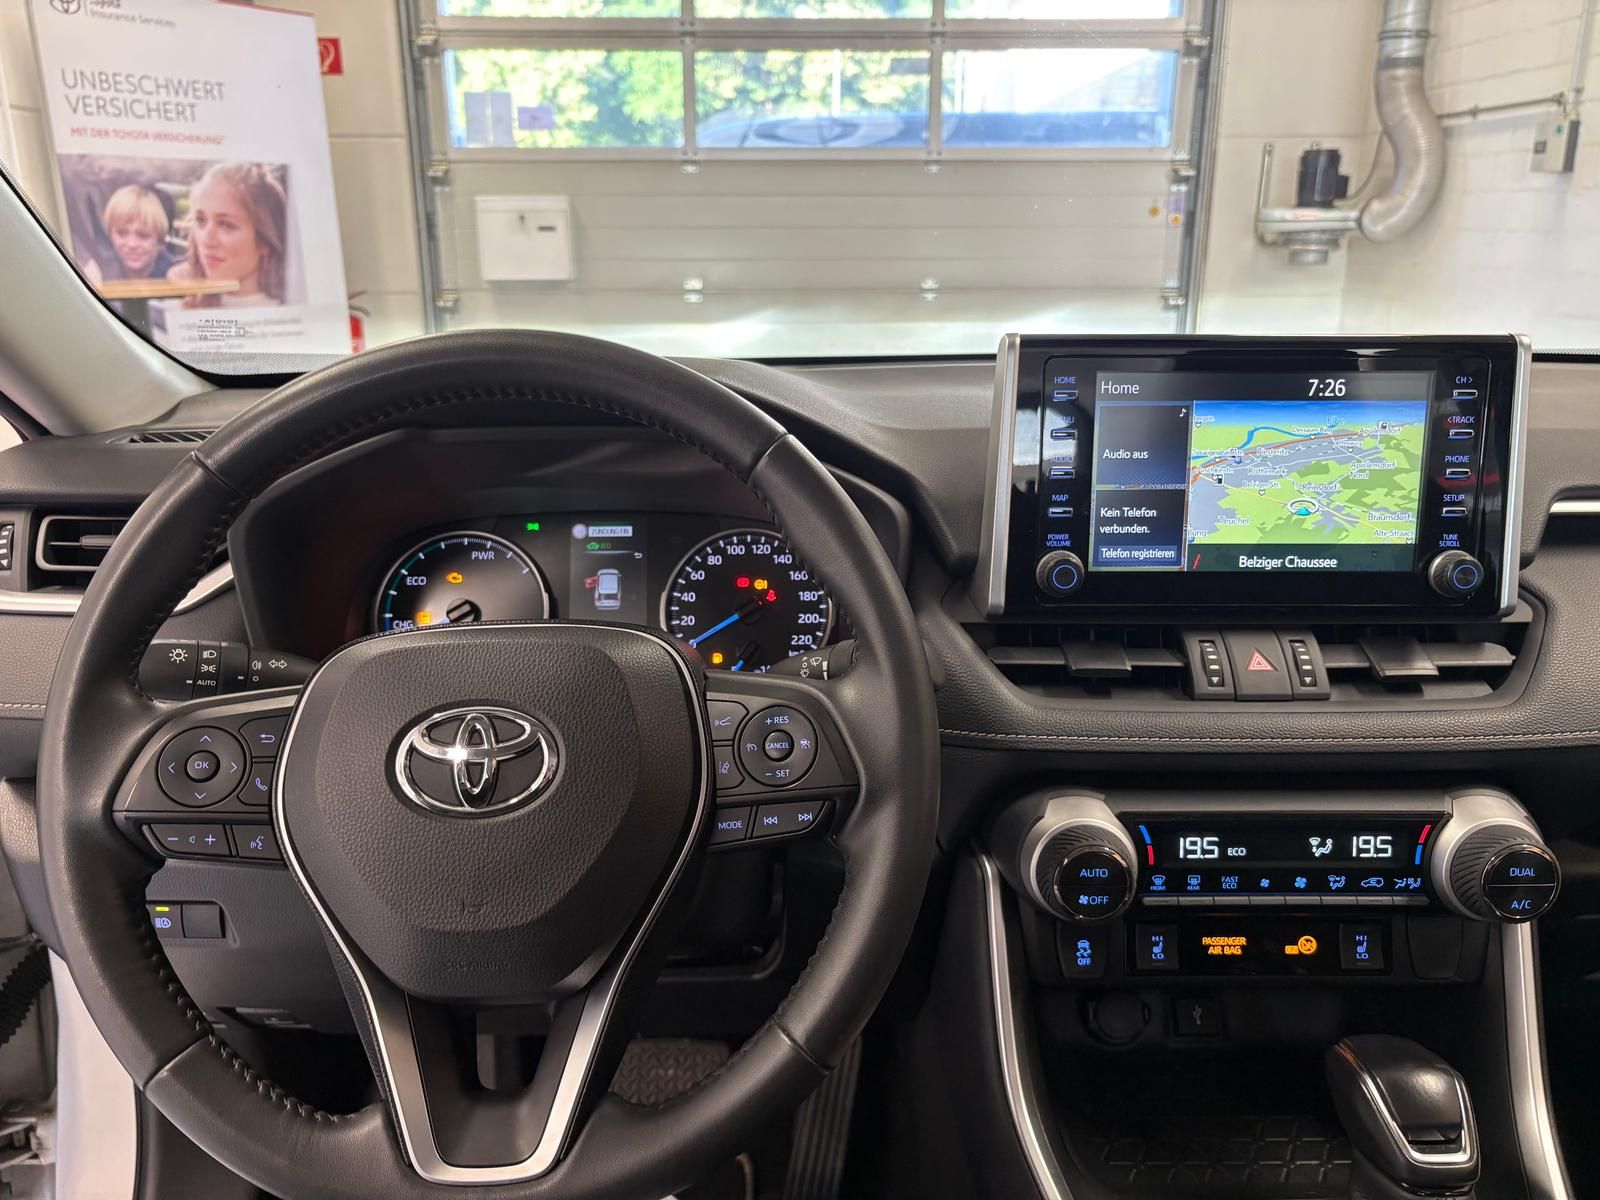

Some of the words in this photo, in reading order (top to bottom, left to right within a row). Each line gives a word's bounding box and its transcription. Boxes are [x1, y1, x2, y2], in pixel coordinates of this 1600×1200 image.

[61, 68, 225, 102] UNBESCHWERT
[64, 94, 198, 123] VERSICHERT
[70, 126, 88, 137] MIT
[91, 128, 109, 138] DER
[112, 129, 149, 141] TOYOTA
[1054, 376, 1076, 384] HOME
[1101, 380, 1140, 394] Home
[1308, 379, 1346, 397] 7:26
[1051, 455, 1073, 463] AUDIO
[1103, 449, 1130, 459] Audio
[1132, 451, 1149, 459] aus
[1444, 455, 1470, 463] PHONE
[1302, 483, 1338, 491] Reinsdorf
[1052, 494, 1068, 502] MAP
[1443, 494, 1465, 502] SETUP
[1100, 507, 1120, 517] Kein
[1122, 507, 1157, 517] Telefon
[1368, 512, 1411, 521] Braunsdorf
[1100, 524, 1150, 533] verbunden.
[726, 545, 745, 555] 100
[752, 544, 771, 554] 120
[1101, 548, 1130, 559] Telefon
[1131, 548, 1175, 560] registrieren
[471, 551, 495, 560] PWR
[707, 555, 722, 565] 80
[772, 555, 792, 564] 140
[1239, 555, 1283, 570] Belziger
[1285, 555, 1338, 568] Chaussee
[690, 570, 705, 580] 60
[789, 570, 808, 580] 160
[406, 576, 427, 585] ECO
[681, 592, 696, 602] 40
[798, 591, 818, 601] 180
[680, 615, 695, 625] 20
[798, 613, 819, 624] 200
[393, 620, 414, 630] CHG
[791, 635, 813, 645] 220
[774, 716, 789, 724] RES
[195, 761, 209, 769] OK
[775, 769, 790, 778] SET
[718, 820, 743, 830] MODE
[1179, 837, 1220, 859] 19.5
[1227, 847, 1247, 856] ECO
[1352, 836, 1393, 857] 19.5
[1080, 868, 1109, 878] AUTO
[1509, 867, 1536, 877] DUAL
[1089, 895, 1109, 904] OFF
[1511, 899, 1532, 910] A/C
[1202, 936, 1247, 946] PASSENGER
[1207, 946, 1223, 955] AIR
[1224, 946, 1242, 955] BAG
[1077, 957, 1092, 966] OFF
